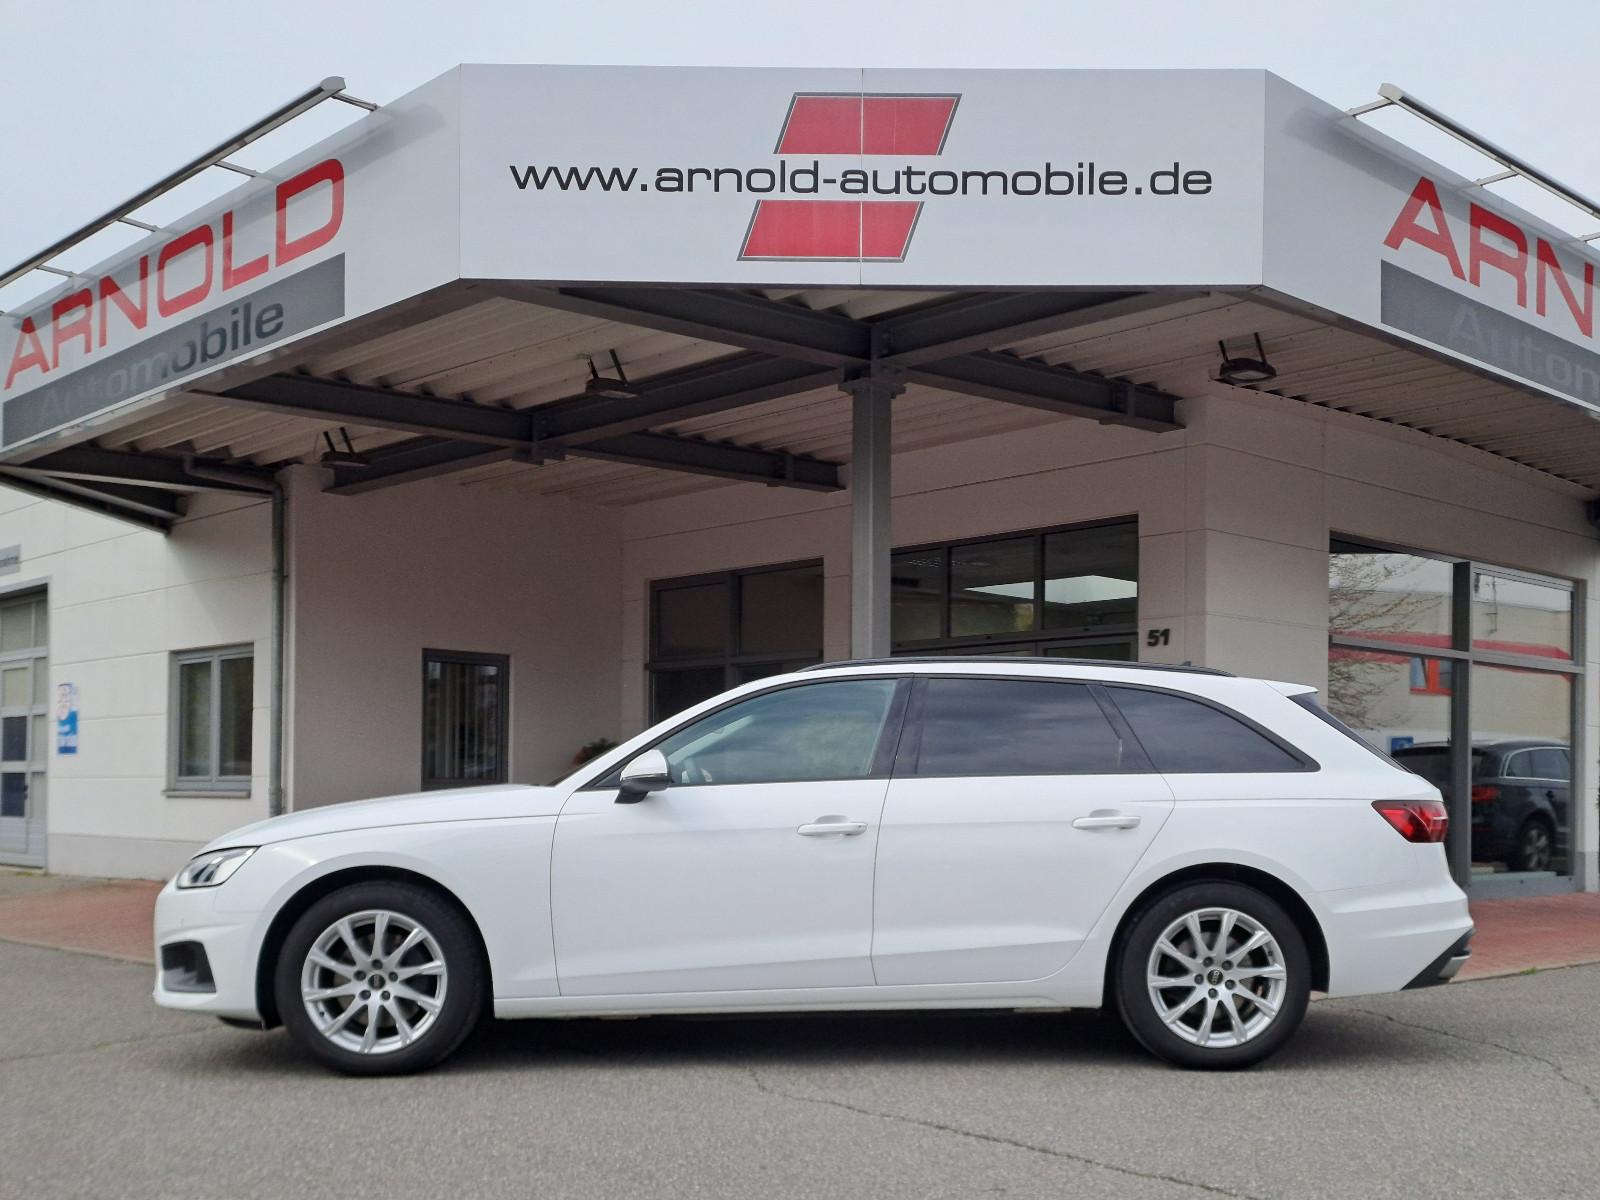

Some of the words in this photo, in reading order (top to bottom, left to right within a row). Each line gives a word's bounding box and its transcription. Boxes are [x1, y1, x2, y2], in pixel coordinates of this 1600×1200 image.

[509, 160, 1213, 196] www.arnold-automobile.de
[4, 158, 345, 390] ARNOLD
[40, 300, 285, 412] Automobile
[1147, 628, 1170, 647] 51
